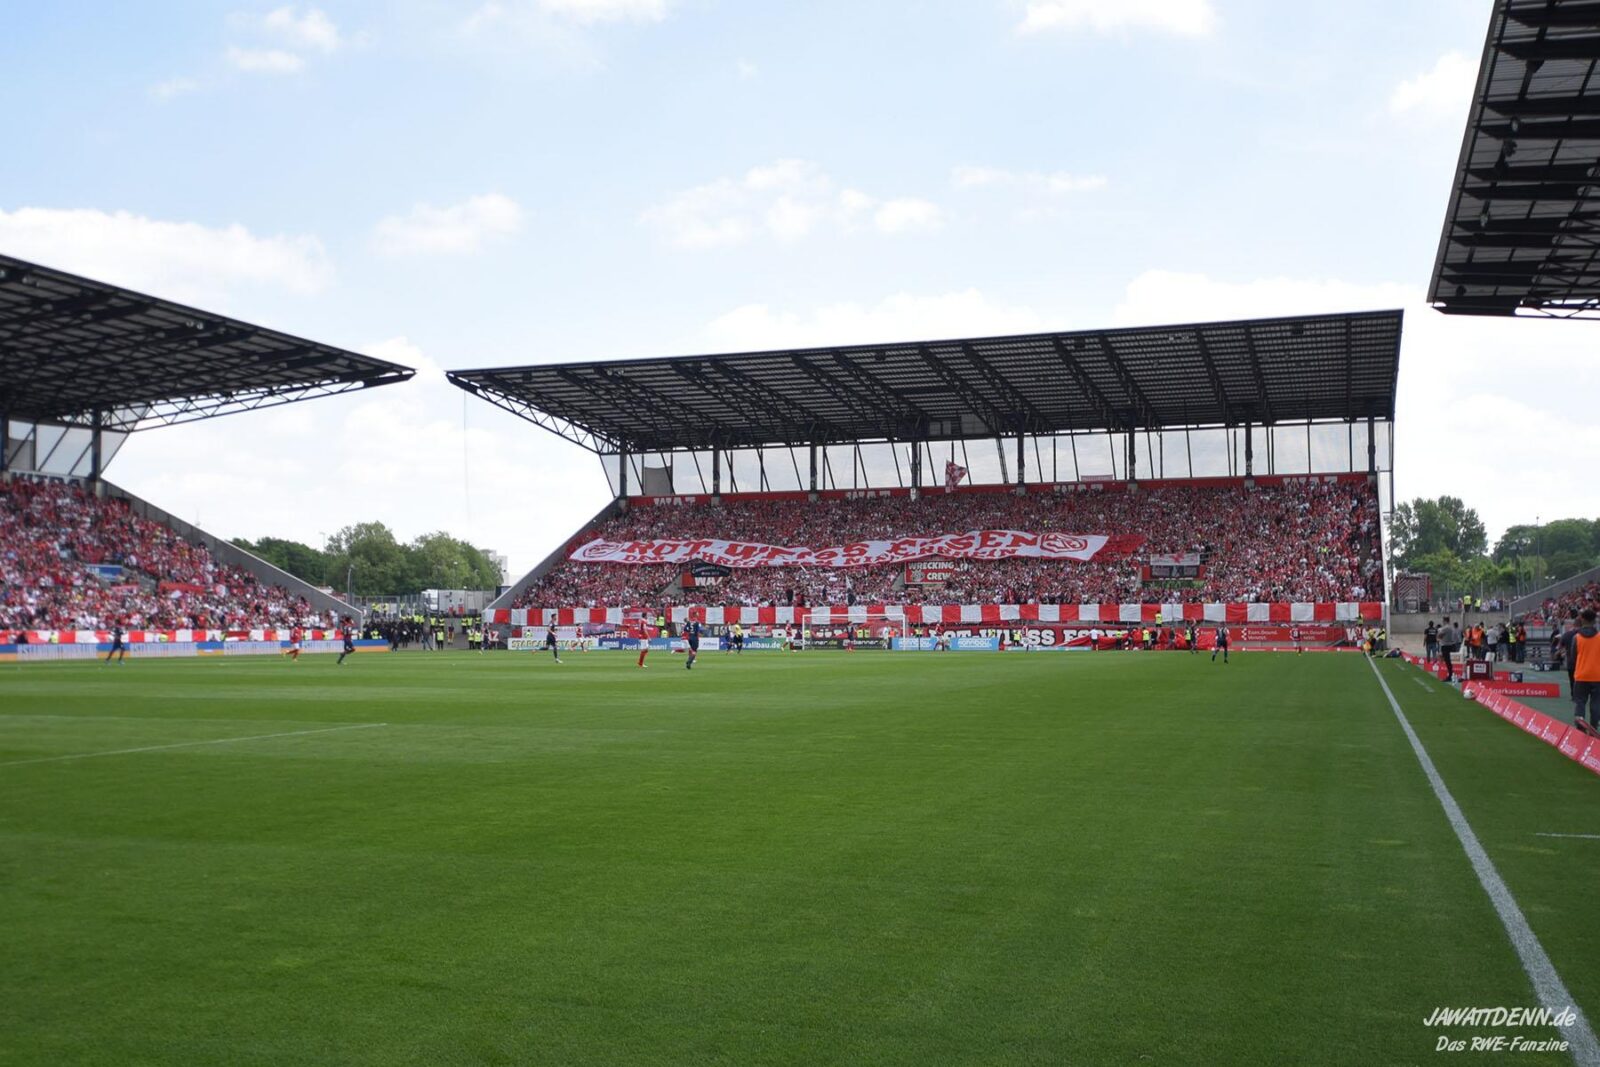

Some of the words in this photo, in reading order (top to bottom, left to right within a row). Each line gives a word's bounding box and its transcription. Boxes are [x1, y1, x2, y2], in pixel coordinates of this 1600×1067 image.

[908, 562, 955, 570] WRECKING
[927, 572, 951, 581] CREW
[1526, 688, 1547, 696] Essen
